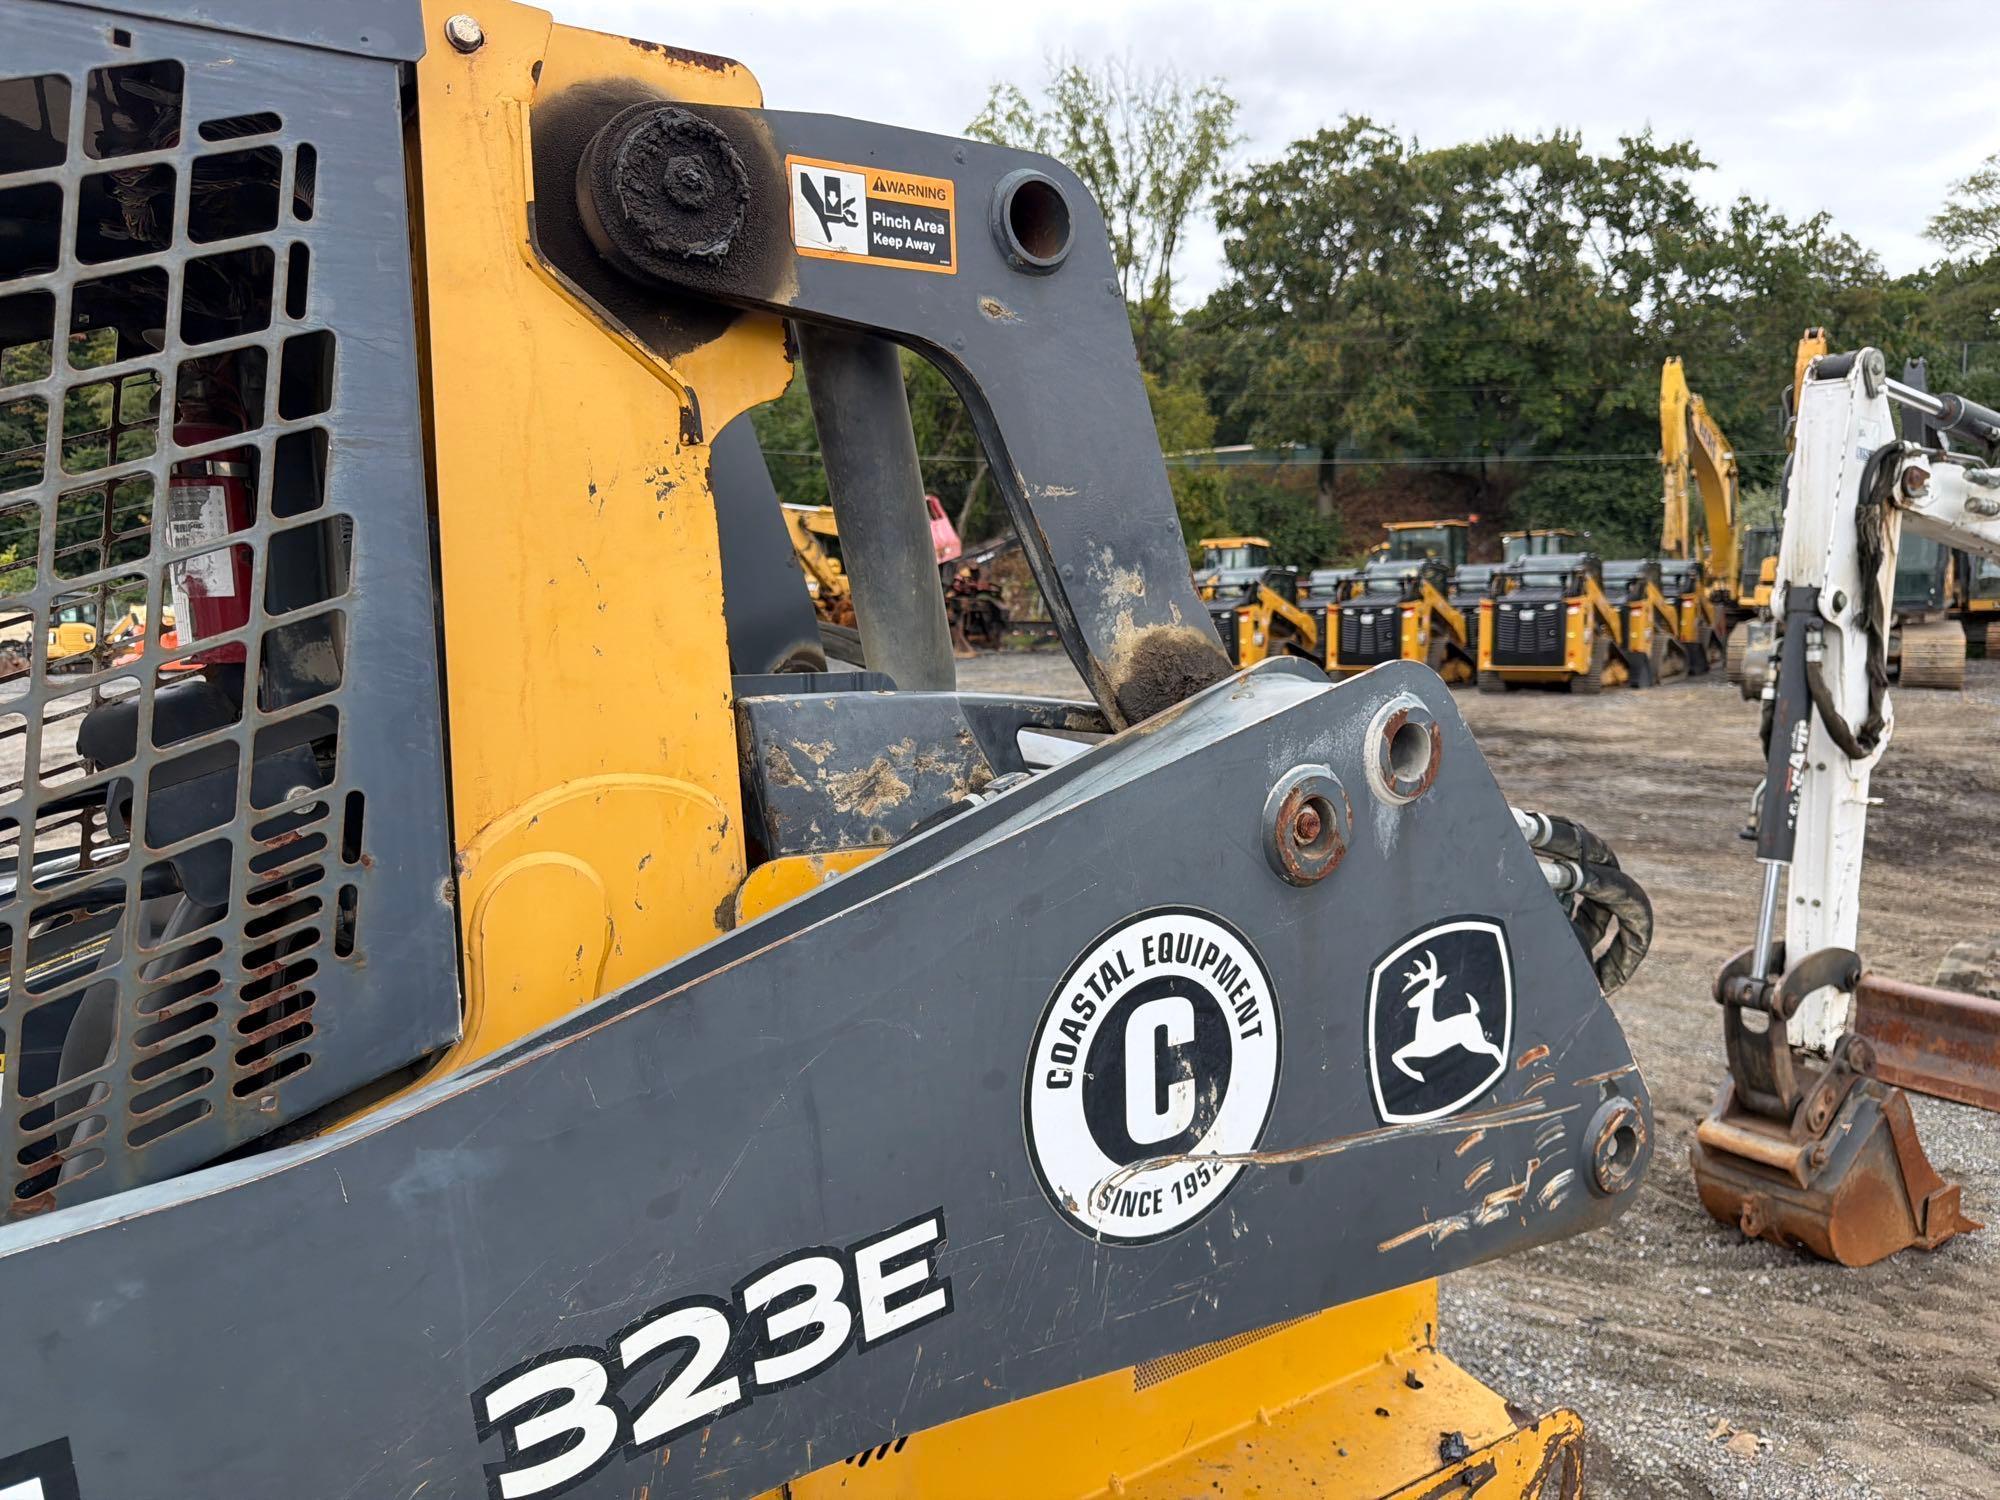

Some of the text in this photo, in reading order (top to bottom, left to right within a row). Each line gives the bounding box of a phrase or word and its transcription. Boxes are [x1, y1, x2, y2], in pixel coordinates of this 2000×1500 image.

[886, 180, 946, 201] WARNING
[872, 210, 945, 235] Pinch Area
[873, 232, 936, 255] Keep Away
[1046, 932, 1263, 1090] COASTAL EQUIPMENT
[1124, 995, 1195, 1146] C
[1097, 1183, 1163, 1218] SINCE
[485, 1218, 947, 1500] 323E
